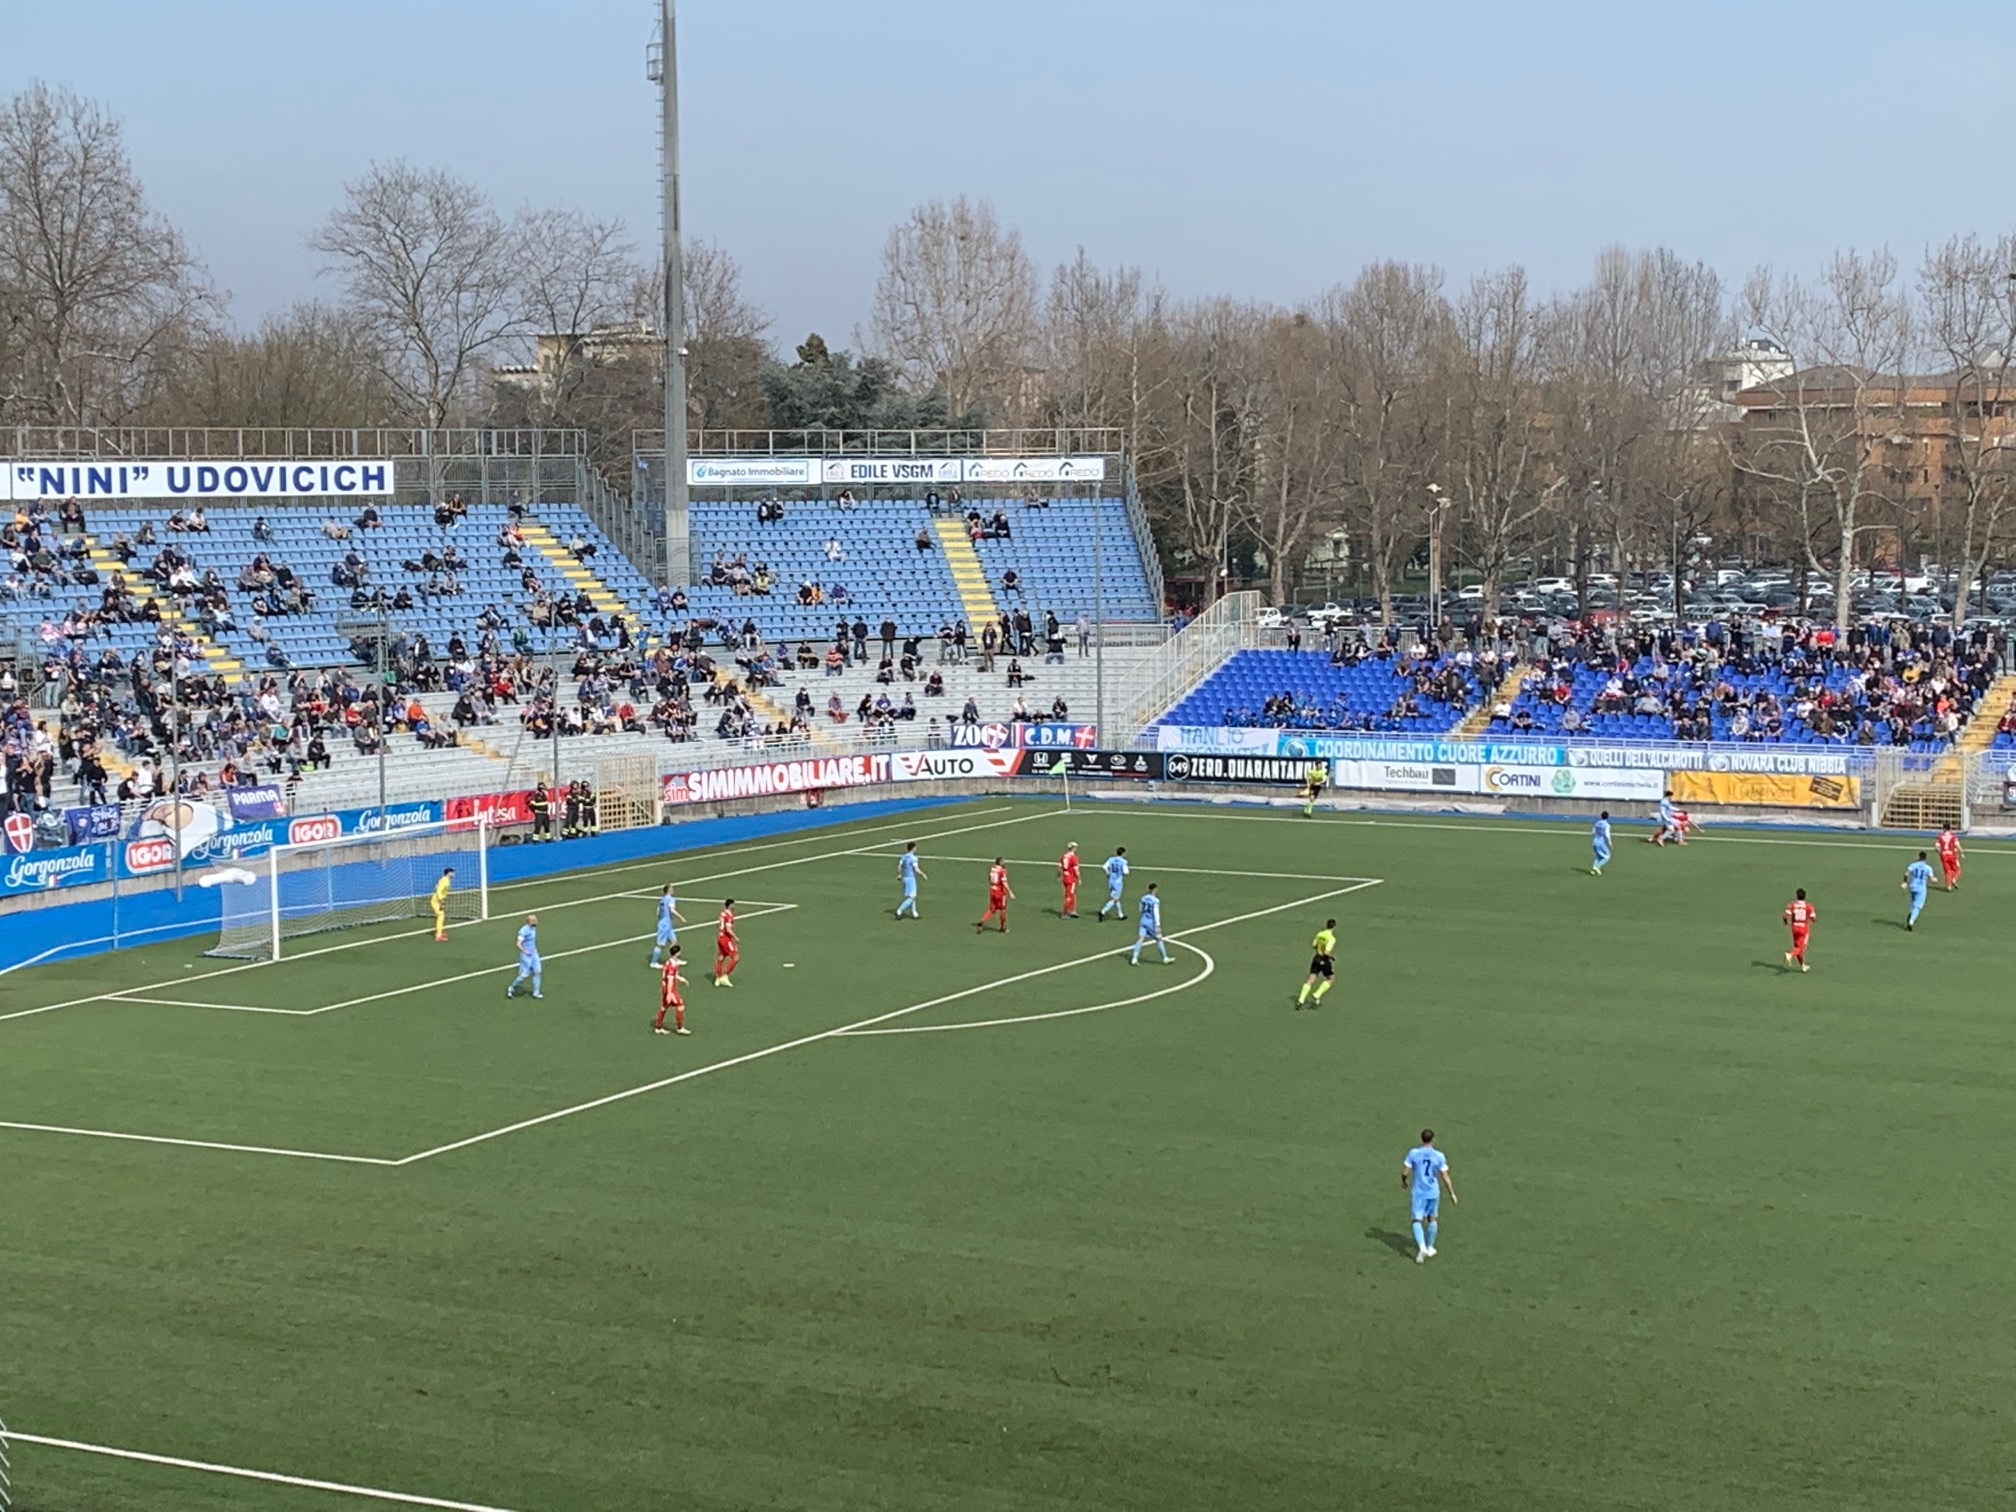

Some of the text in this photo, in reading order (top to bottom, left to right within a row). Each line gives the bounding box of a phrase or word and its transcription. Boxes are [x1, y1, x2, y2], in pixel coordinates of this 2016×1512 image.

[166, 466, 385, 494] UDOVICICH
[708, 466, 804, 478] Bagnato Immobiliare
[851, 464, 888, 478] EDILE
[892, 464, 934, 478] VSGM
[1024, 727, 1074, 745] C.D.M.
[1315, 740, 1558, 765] COORDINAMENTO CUORE AZZURRO
[1590, 750, 1624, 767] QUELLI
[1168, 763, 1188, 773] 049
[1731, 754, 1774, 771] NOVARA
[1777, 755, 1806, 772] CLUB
[688, 755, 889, 801] SIMIMMOBILIARE.IT
[1384, 766, 1429, 779] Techbau
[1487, 768, 1541, 789] CORTINI
[232, 789, 279, 805] PARMA
[294, 822, 335, 842] IGOR
[130, 844, 173, 866] IGOR
[5, 848, 94, 887] Gorgonzola
[1423, 1159, 1431, 1177] 7
